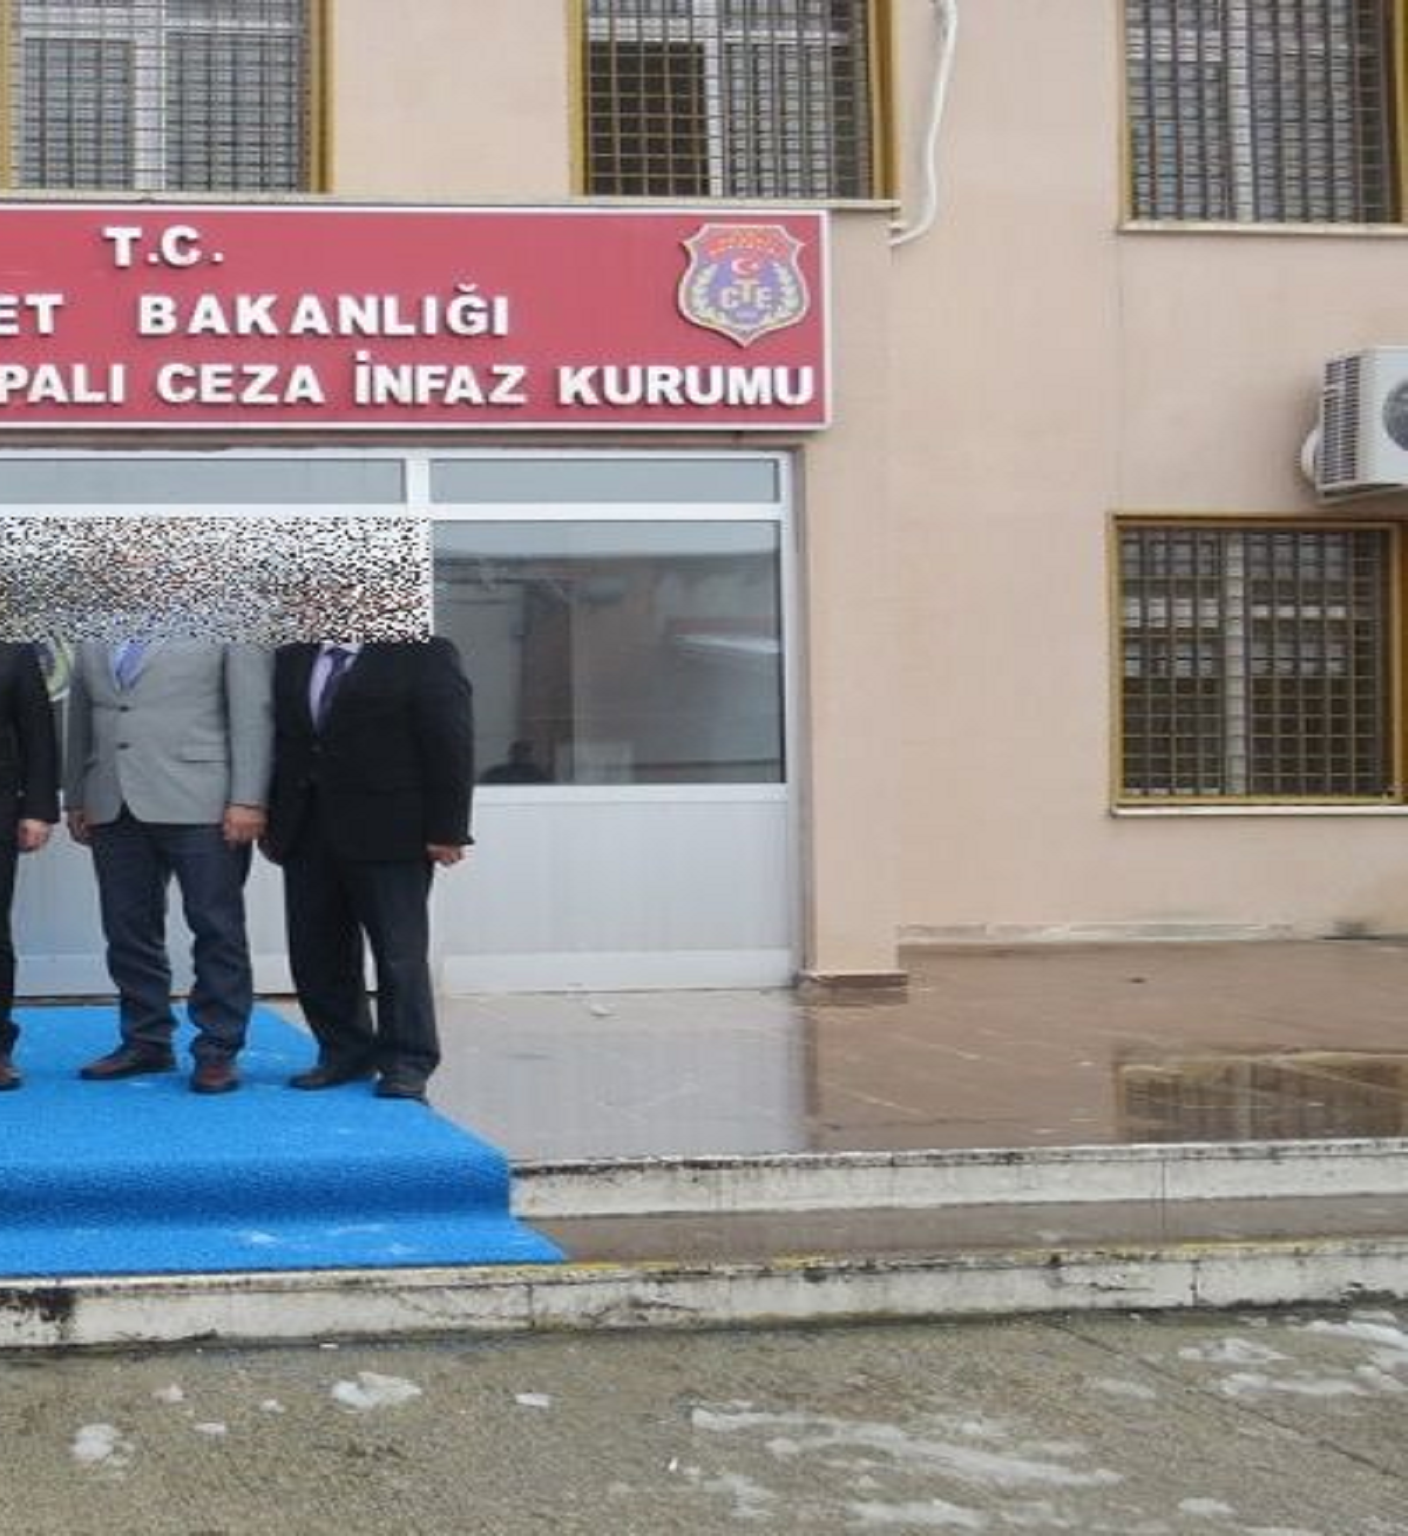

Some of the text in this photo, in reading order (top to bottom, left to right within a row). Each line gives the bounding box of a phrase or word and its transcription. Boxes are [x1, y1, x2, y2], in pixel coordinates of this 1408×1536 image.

[103, 225, 224, 266] T.C.
[138, 283, 509, 336] BAKANLIĞI
[720, 279, 773, 309] CTE
[155, 362, 325, 404] CEZA
[354, 348, 527, 404] İNFAZ
[558, 364, 815, 406] KURUMU
